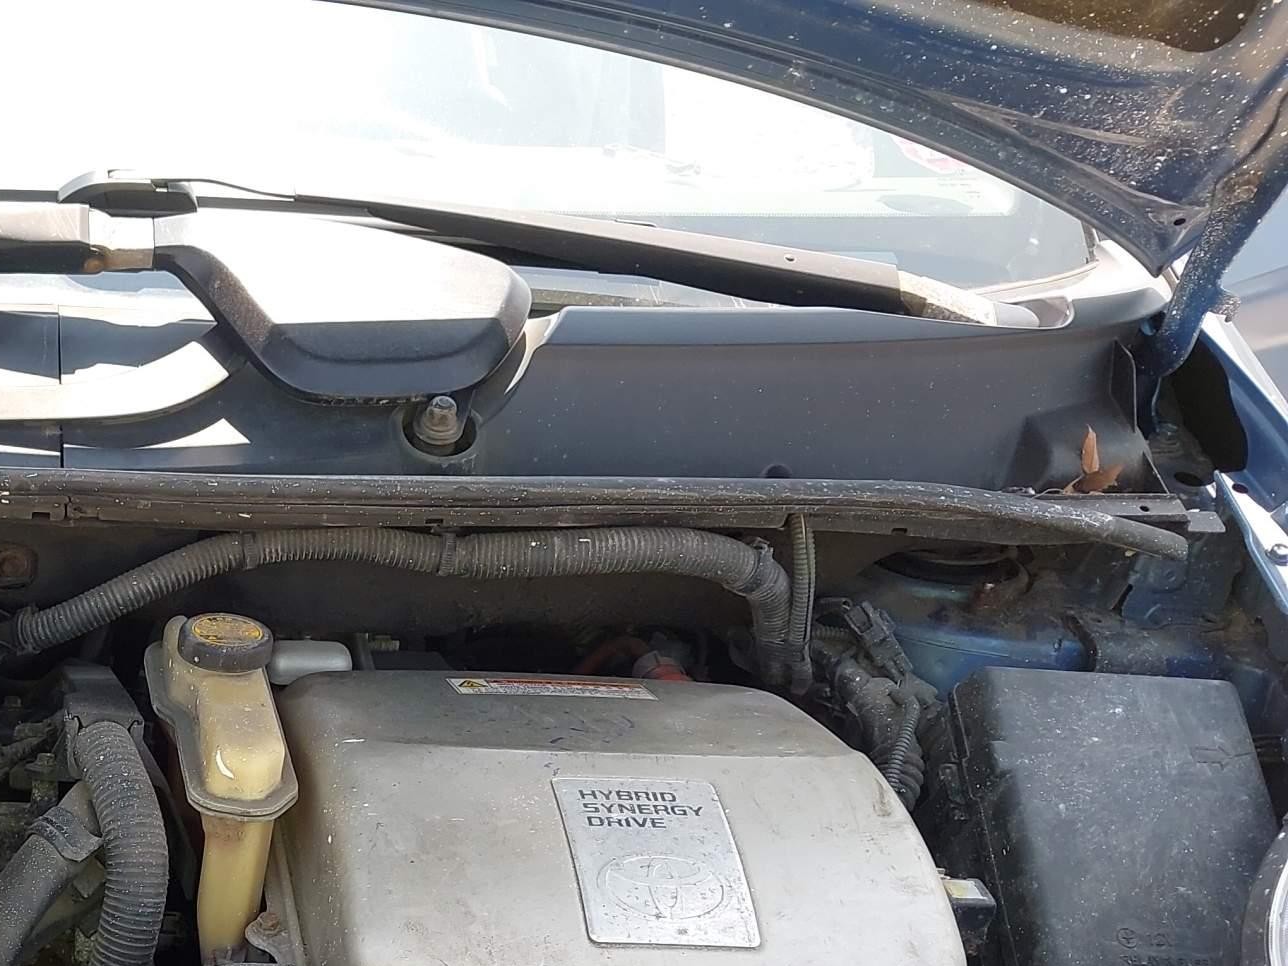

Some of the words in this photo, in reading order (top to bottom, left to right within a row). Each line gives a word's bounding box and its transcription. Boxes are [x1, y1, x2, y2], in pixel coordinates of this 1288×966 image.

[578, 789, 677, 802] HYBRID
[582, 802, 703, 817] SYNERGY
[586, 815, 667, 829] DRIVE
